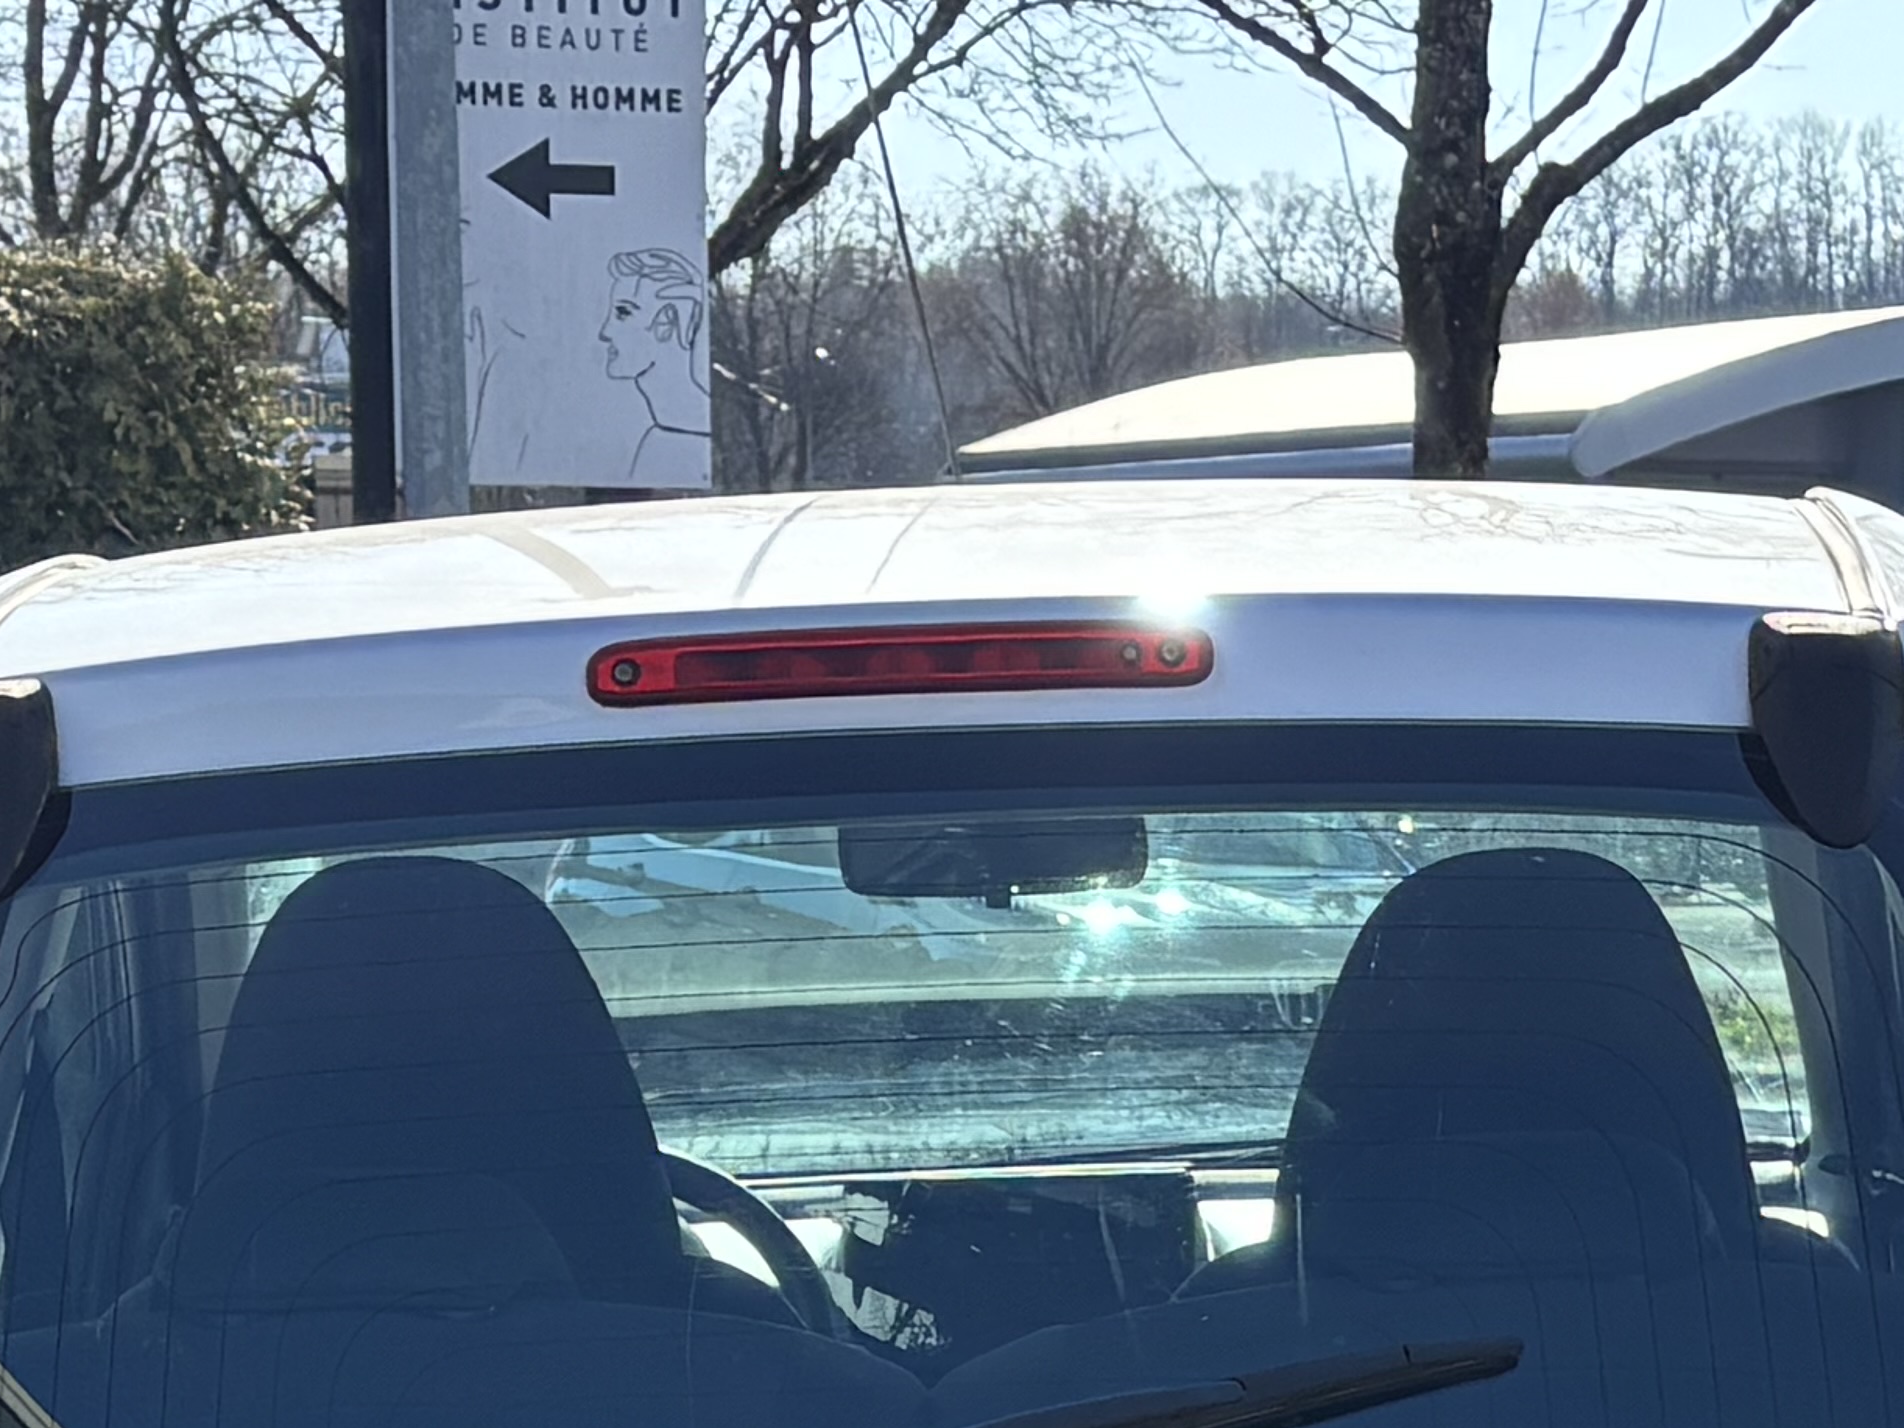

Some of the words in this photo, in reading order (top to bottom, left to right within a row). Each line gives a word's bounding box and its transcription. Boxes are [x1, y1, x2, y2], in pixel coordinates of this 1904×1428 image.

[511, 22, 649, 52] BEAUTÉ
[455, 81, 524, 108] MME
[538, 83, 557, 109] &
[570, 85, 683, 113] HOMME
